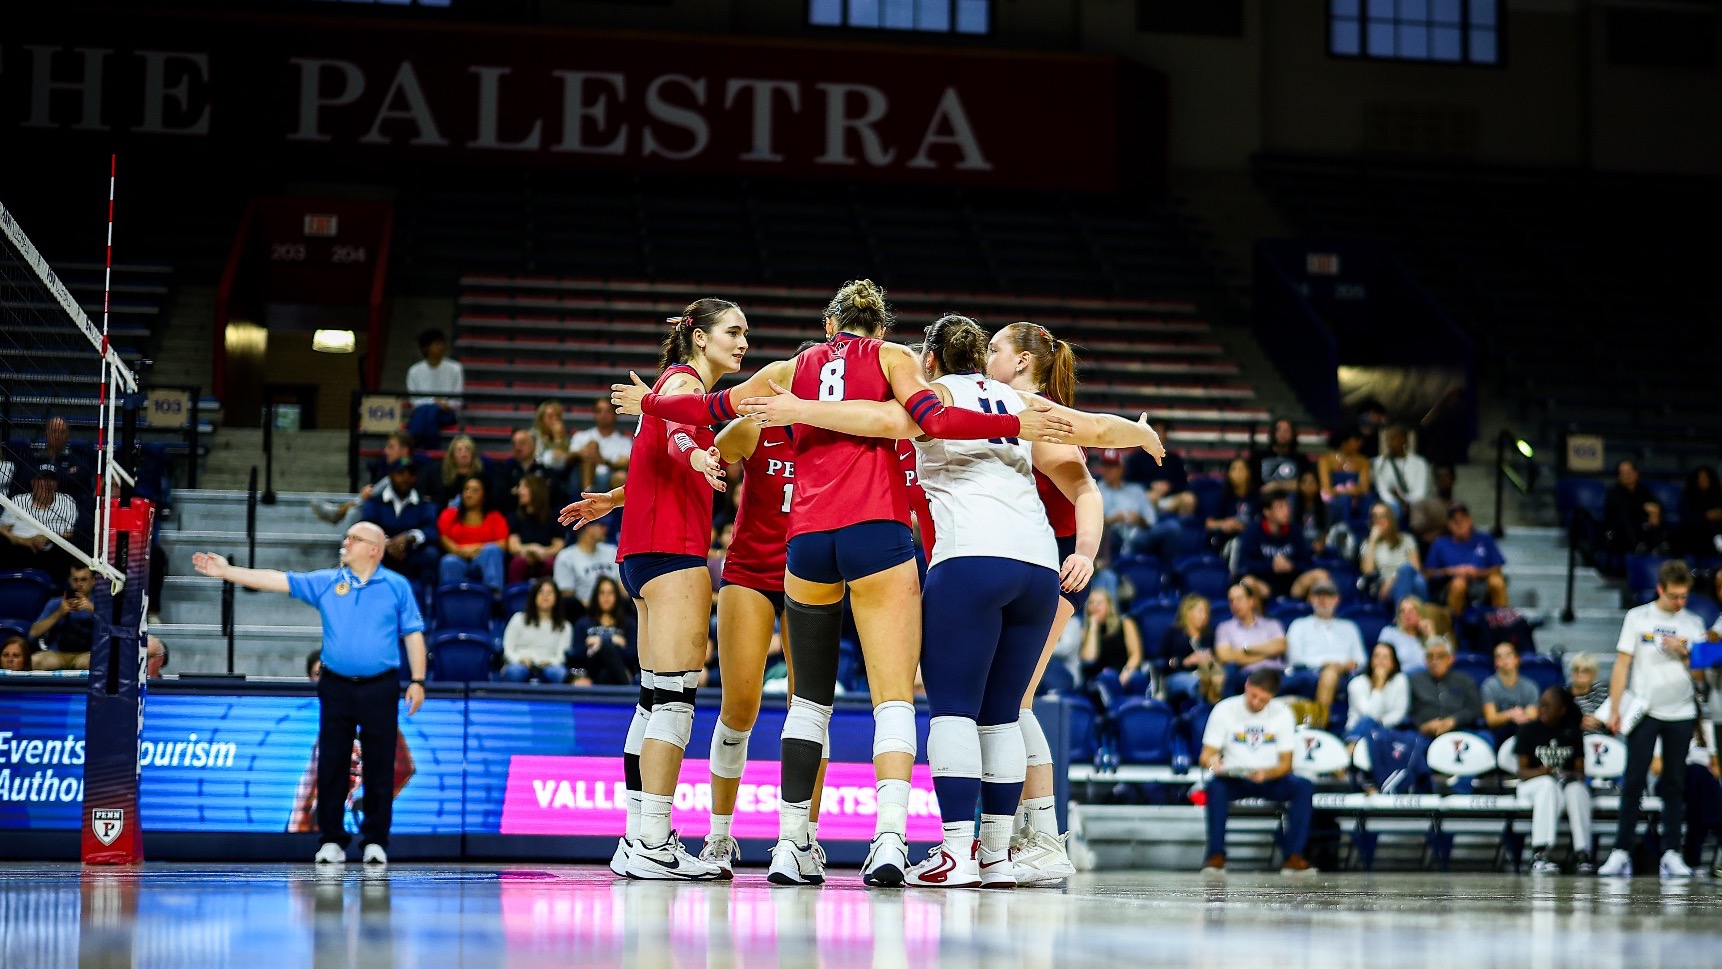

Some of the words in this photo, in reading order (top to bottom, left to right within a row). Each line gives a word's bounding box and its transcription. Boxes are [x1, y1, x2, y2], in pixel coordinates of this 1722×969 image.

[0, 42, 212, 136] HE
[284, 56, 994, 170] PALESTRA
[330, 244, 366, 263] 204
[819, 358, 846, 401] 8
[368, 405, 394, 421] 104
[766, 458, 794, 477] PE
[140, 732, 236, 767] ourism
[95, 811, 121, 820] PENN
[103, 822, 115, 837] P
